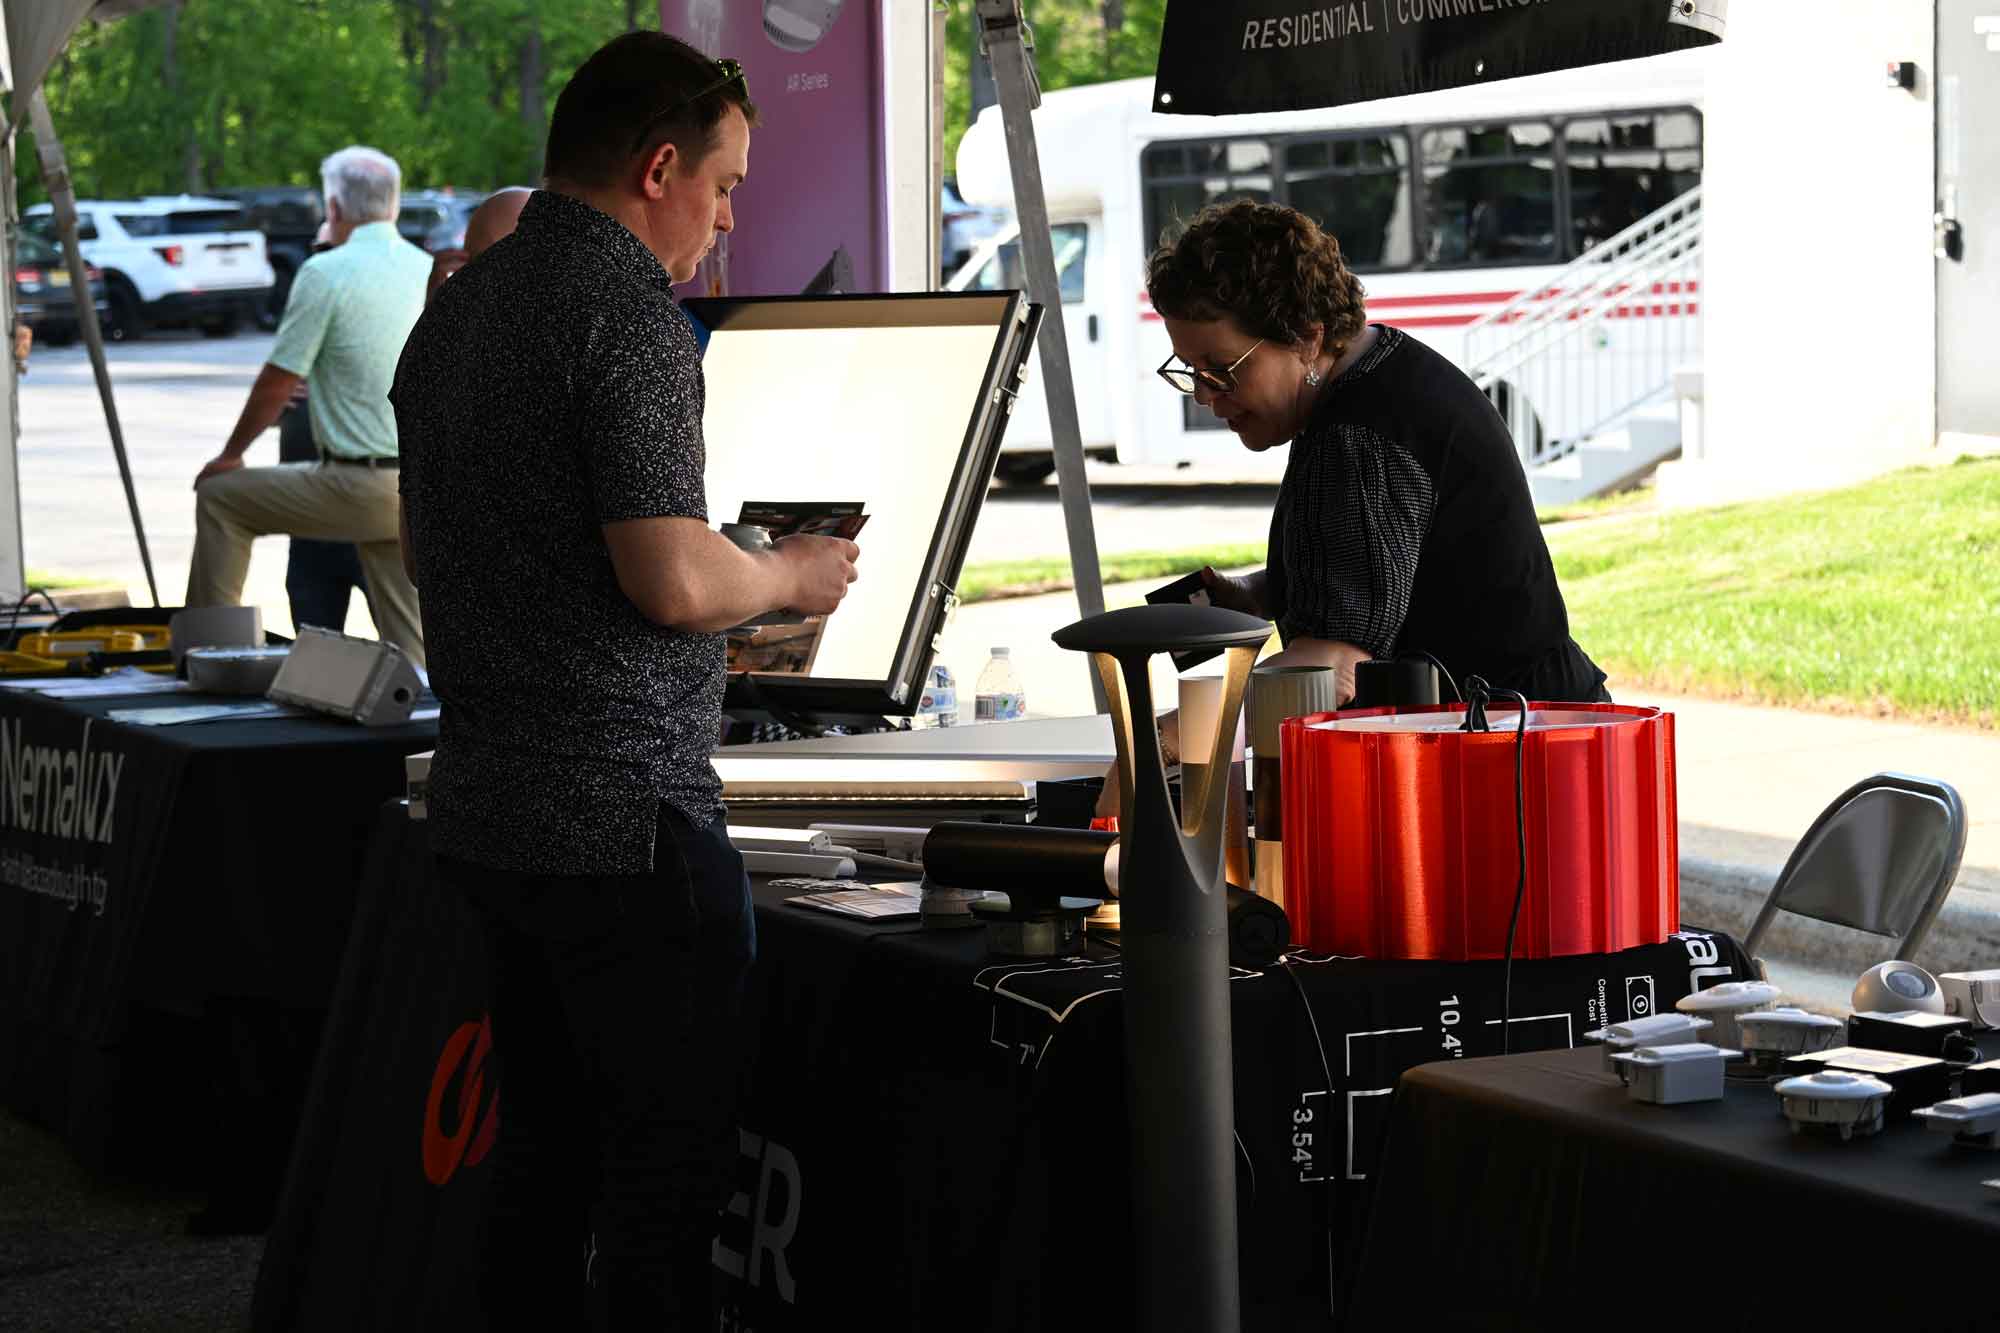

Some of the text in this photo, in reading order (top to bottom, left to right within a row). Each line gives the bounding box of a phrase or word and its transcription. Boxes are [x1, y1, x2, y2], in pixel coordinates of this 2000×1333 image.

[1242, 1, 1375, 50] RESIDENTIAL
[801, 72, 829, 91] Series
[0, 716, 125, 845] Nemalux
[1439, 994, 1463, 1057] 10.4"
[1588, 998, 1597, 1022] Cost
[1597, 978, 1609, 1032] Competitiv
[1292, 1107, 1314, 1171] 3.54"
